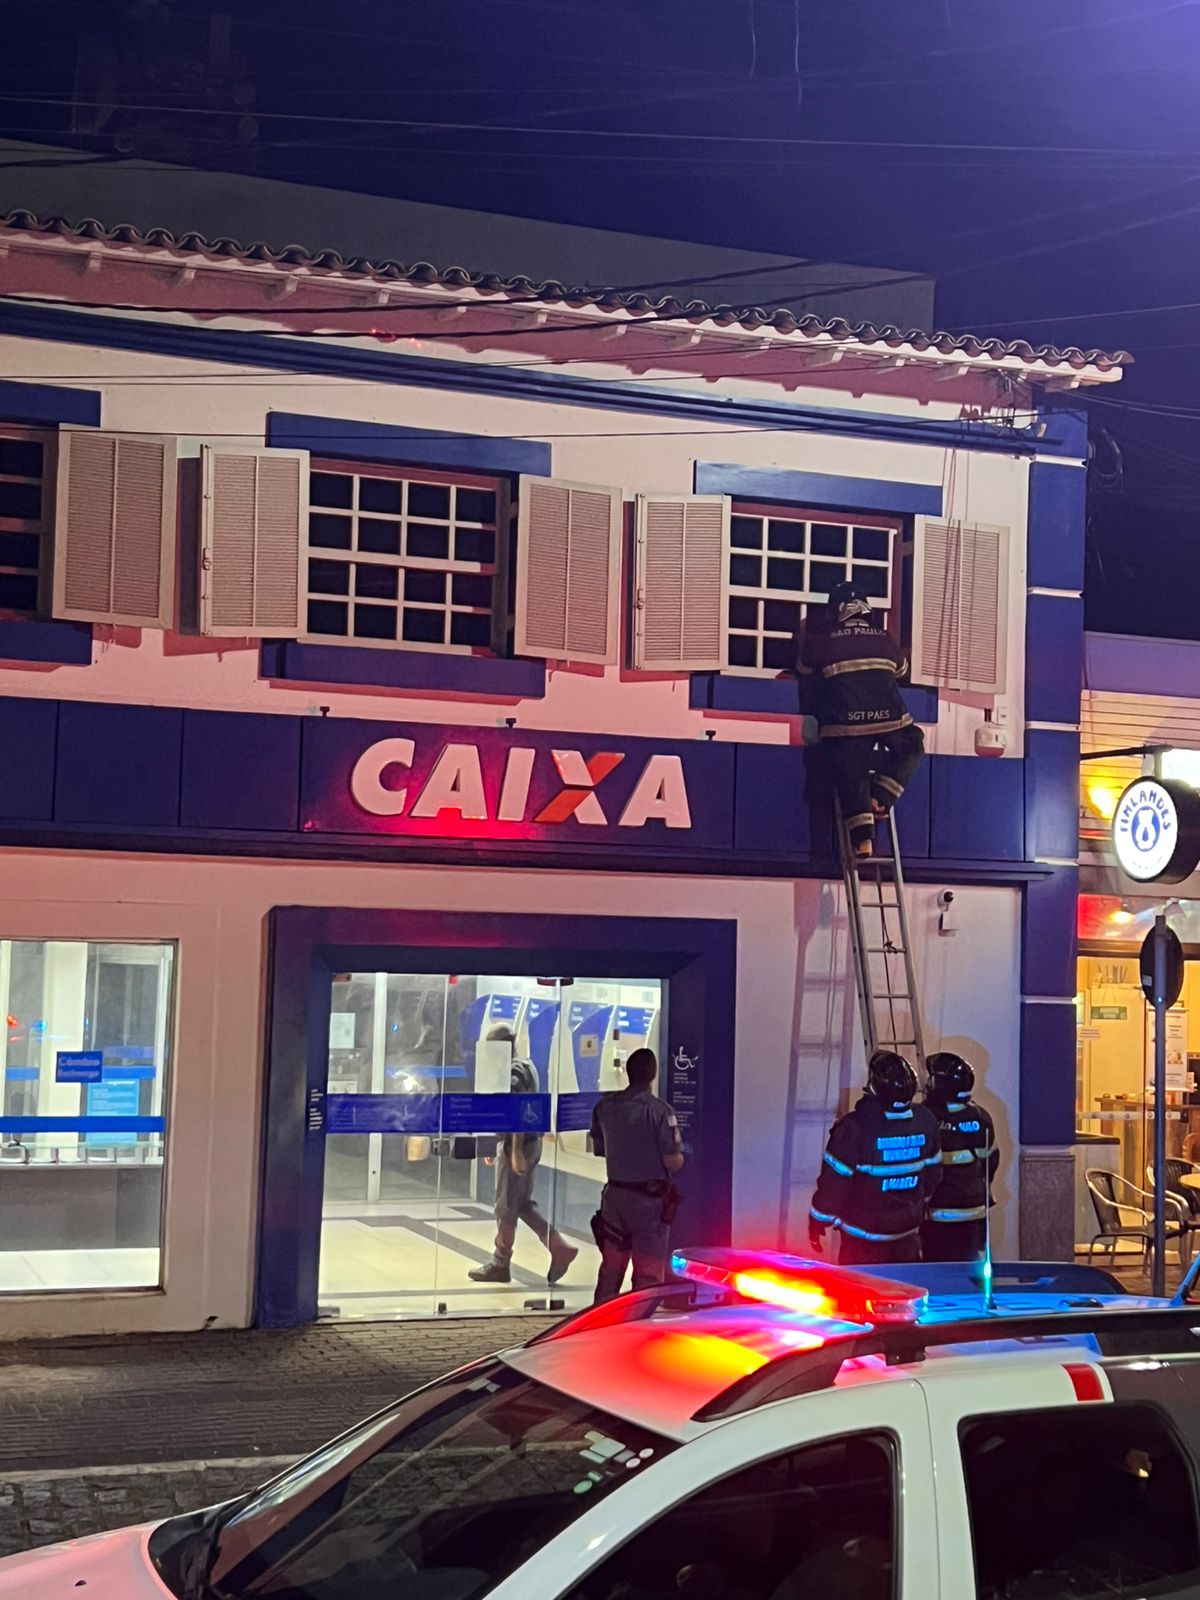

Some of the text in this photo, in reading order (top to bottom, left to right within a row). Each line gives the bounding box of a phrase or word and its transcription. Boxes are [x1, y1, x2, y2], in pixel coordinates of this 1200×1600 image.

[848, 709, 890, 720] SGT PAES
[351, 738, 692, 828] CAIXA
